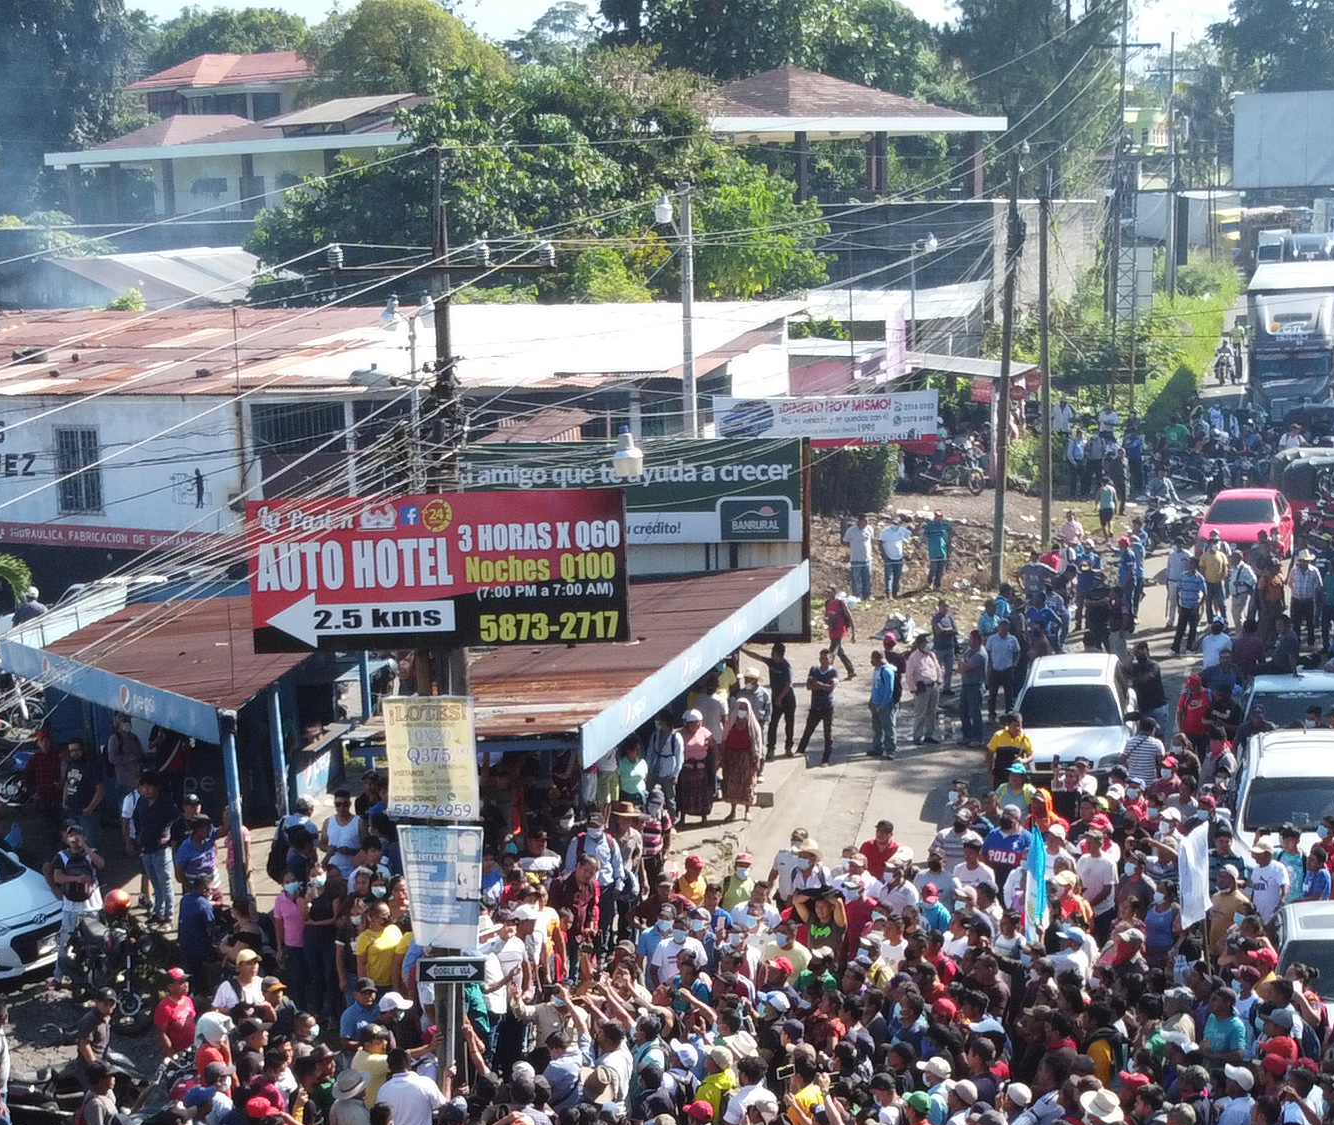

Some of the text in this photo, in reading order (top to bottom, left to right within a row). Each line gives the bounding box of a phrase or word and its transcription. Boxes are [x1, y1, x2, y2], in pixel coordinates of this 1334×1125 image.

[826, 400, 850, 412] HOY
[852, 398, 891, 411] MISMO!
[477, 464, 547, 489] amigo
[552, 467, 594, 488] que
[701, 465, 715, 482] a
[720, 460, 792, 482] crecer
[429, 508, 444, 520] 24
[633, 521, 681, 535] crédito!
[732, 520, 780, 530] BANRURAL
[69, 530, 128, 544] FABRICACION
[133, 534, 145, 545] DE
[457, 520, 620, 551] 3 HORAS X Q60
[257, 537, 453, 592] AUTO HOTEL
[466, 552, 615, 584] Noches Q100
[476, 583, 614, 602] (7:00 PM a 7:00 AM)
[314, 606, 442, 631] 2.5 kms
[480, 610, 619, 643] 5873-2717
[389, 704, 467, 726] ¡LOTES!
[394, 804, 472, 817] 5827-6959
[988, 849, 1016, 864] POLO
